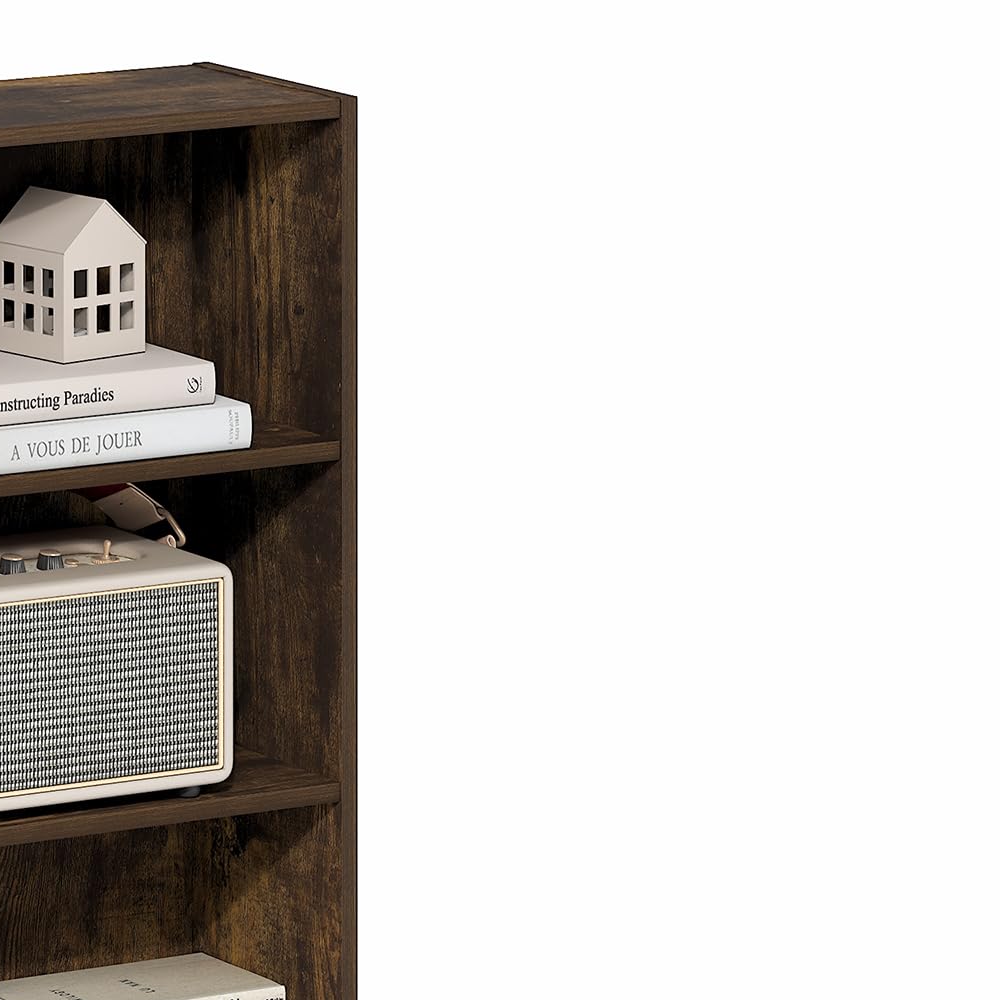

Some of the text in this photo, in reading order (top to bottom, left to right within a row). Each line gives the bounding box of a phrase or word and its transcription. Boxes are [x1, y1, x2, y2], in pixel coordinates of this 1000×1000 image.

[63, 386, 115, 406] Paradies
[10, 430, 143, 461] A VOUS DE JOUER
